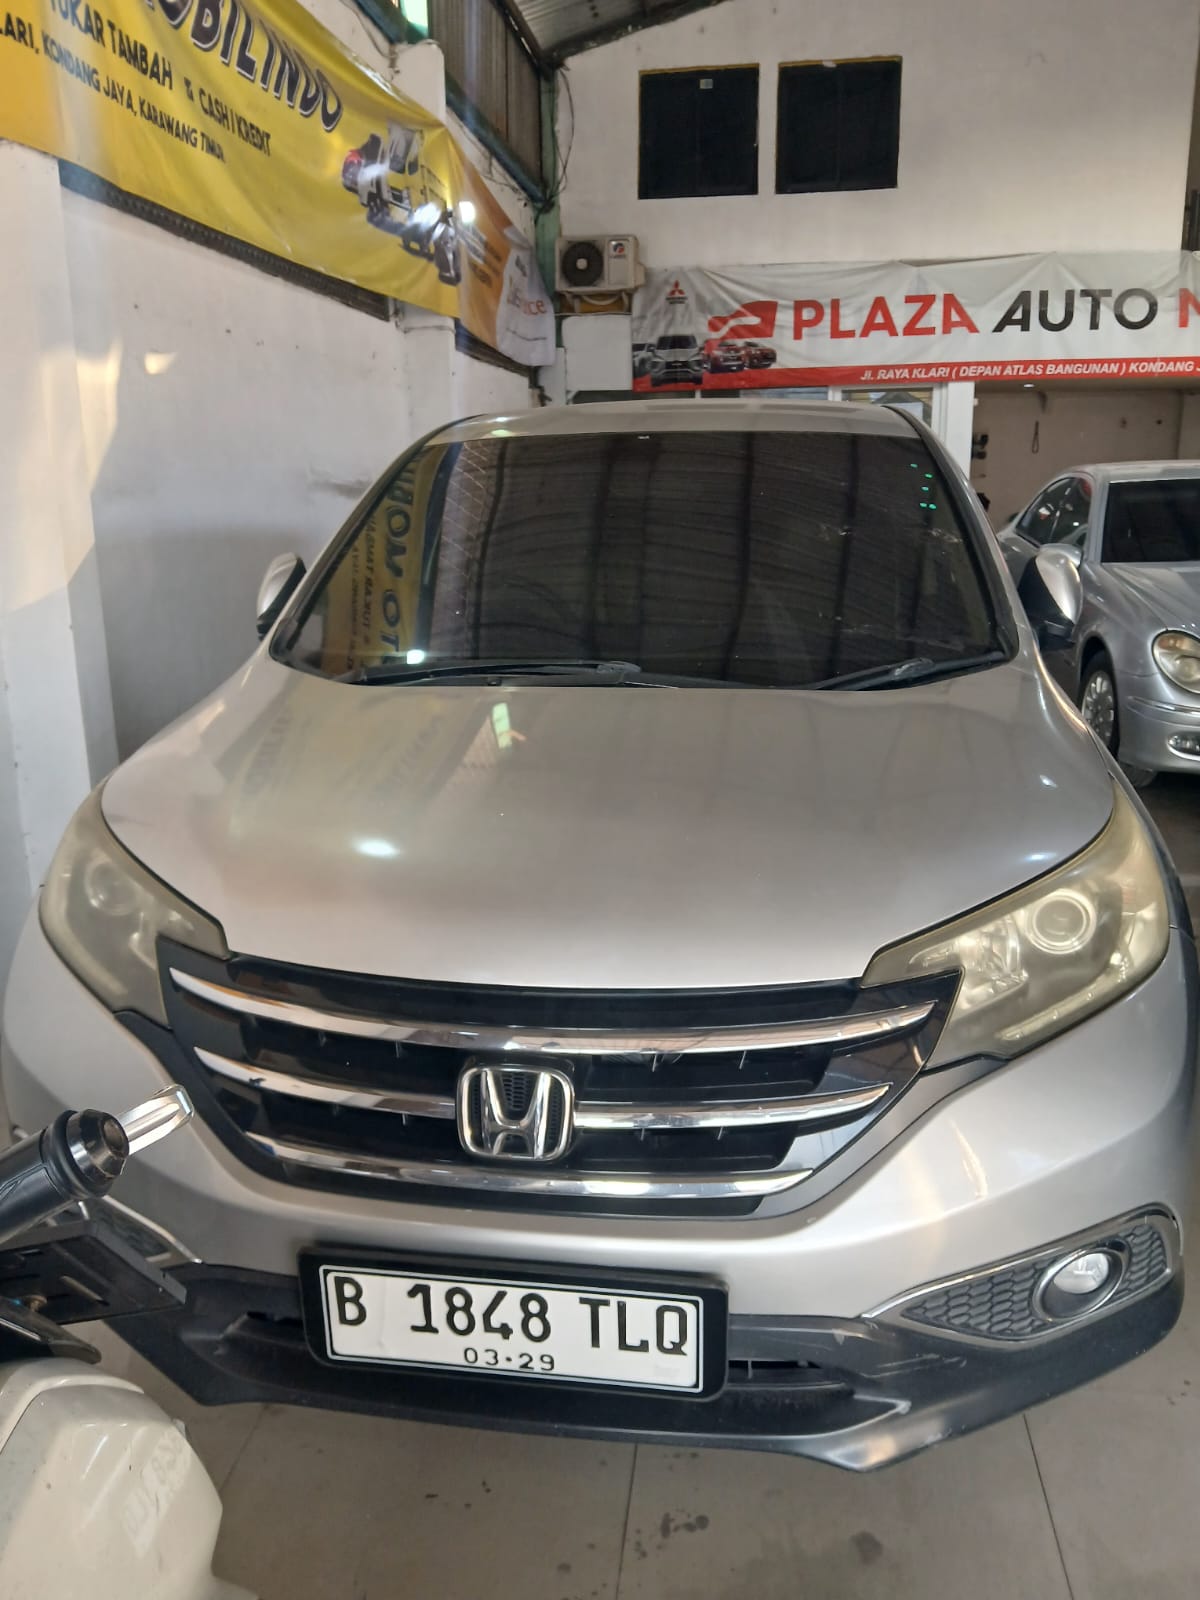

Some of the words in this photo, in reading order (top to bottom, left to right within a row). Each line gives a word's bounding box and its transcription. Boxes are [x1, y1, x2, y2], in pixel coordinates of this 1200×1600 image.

[42, 30, 100, 92] KONDANG
[139, 96, 198, 148] KARAWANG
[107, 19, 173, 90] TAMBAH
[793, 293, 980, 340] PLAZA
[992, 288, 1158, 332] AUTO
[876, 369, 909, 380] RAYA
[912, 367, 950, 379] KLARI
[959, 366, 1001, 377] DEPAN
[1002, 364, 1043, 376] ATLAS
[1045, 363, 1119, 375] BANGUNAN
[1128, 361, 1195, 373] KONDANG
[333, 1276, 367, 1327] B
[407, 1283, 551, 1343] 1848
[579, 1297, 688, 1357] TLQ
